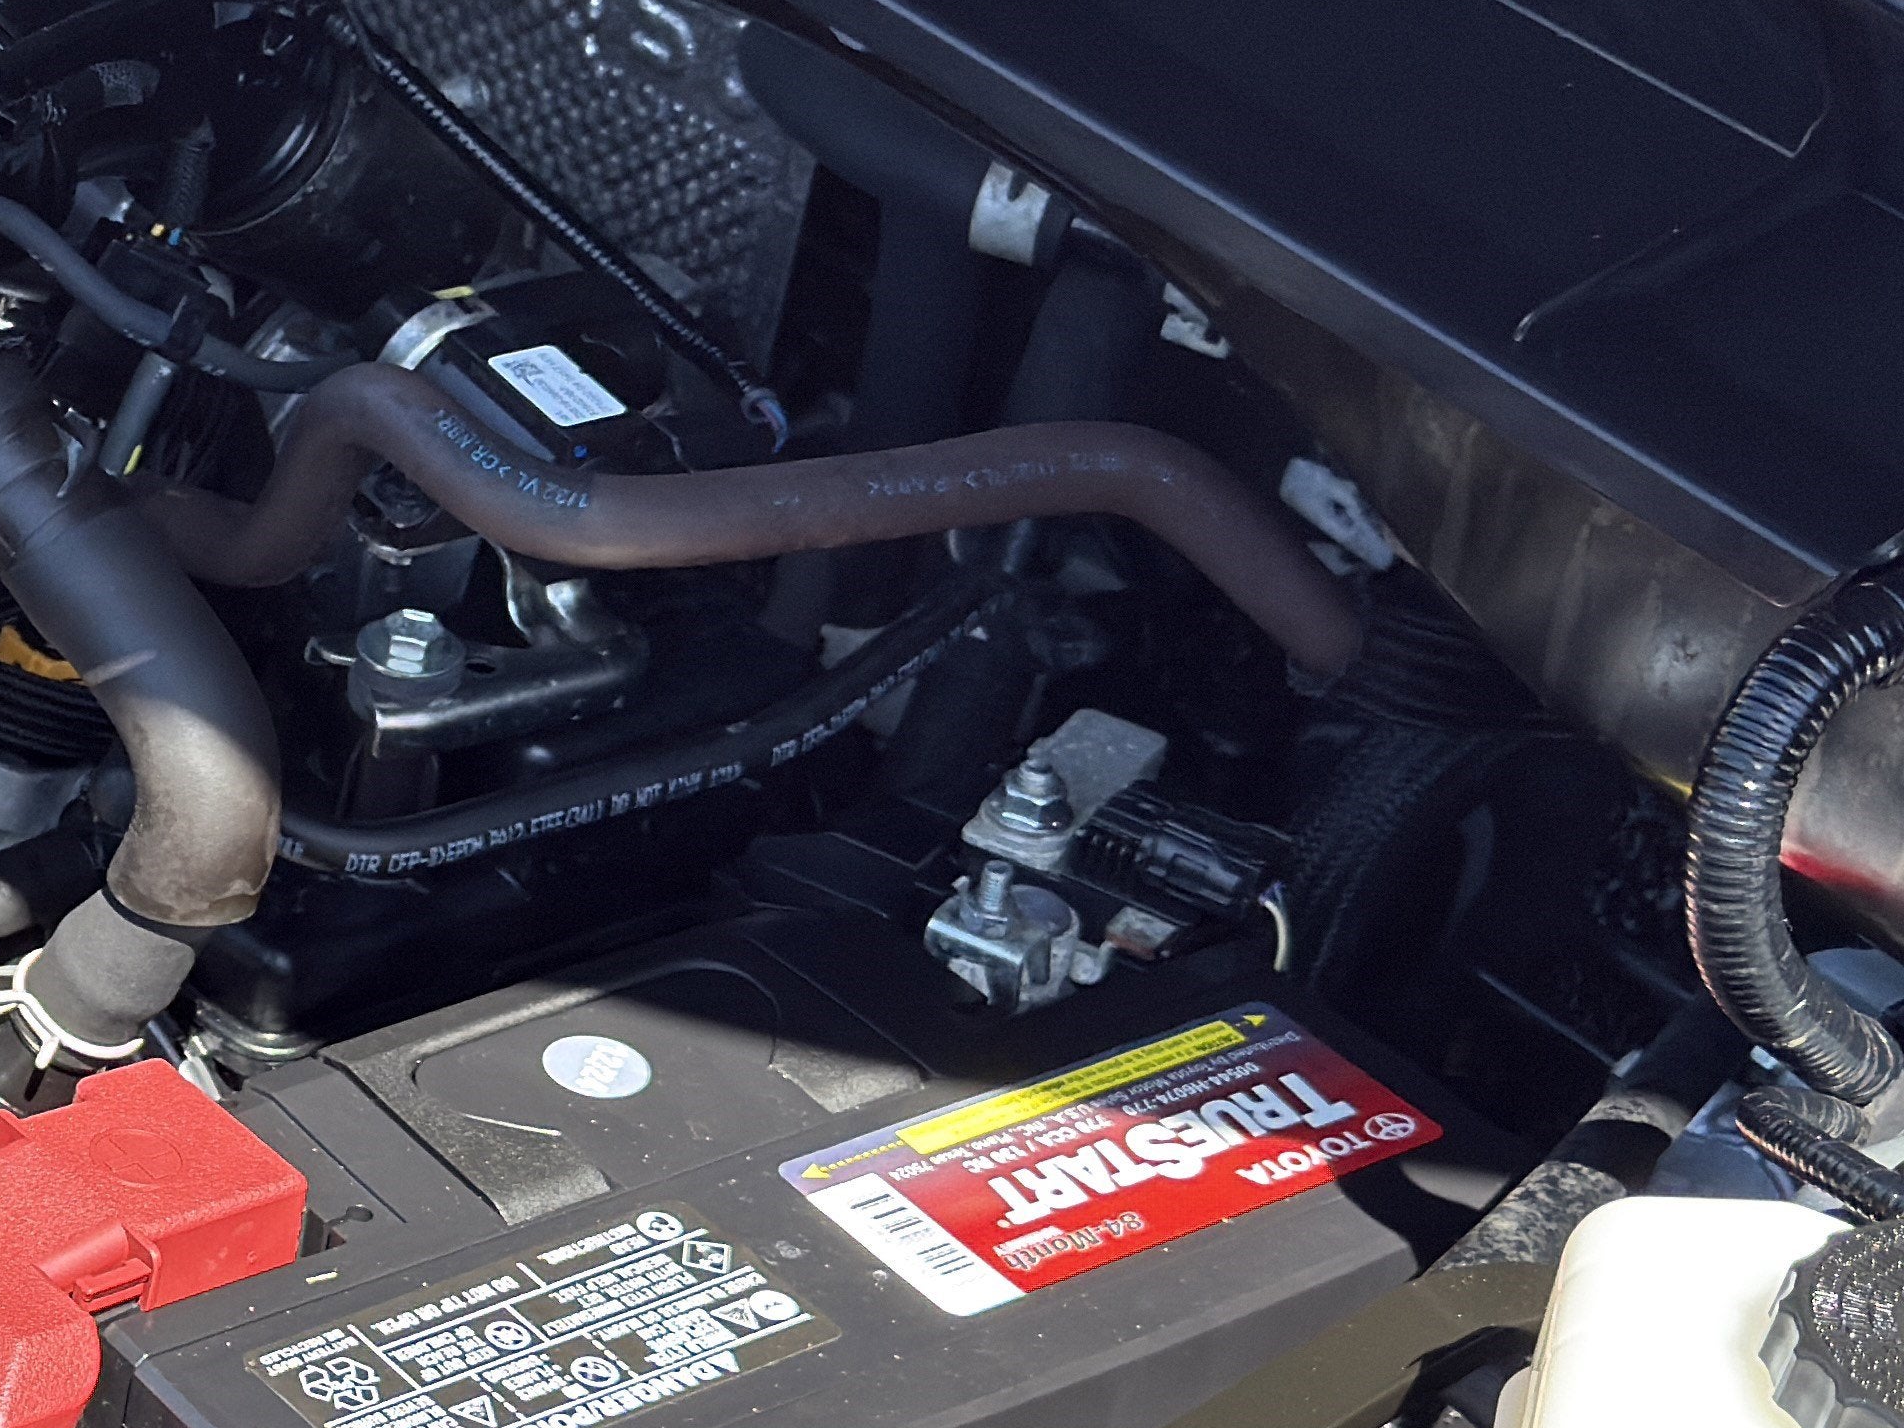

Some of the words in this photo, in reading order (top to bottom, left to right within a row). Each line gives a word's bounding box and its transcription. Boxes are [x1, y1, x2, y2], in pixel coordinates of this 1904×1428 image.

[344, 852, 383, 873] DTR
[1031, 1124, 1081, 1148] CCA
[1233, 1127, 1374, 1188] TOYOTA
[998, 1209, 1148, 1273] 84-Month
